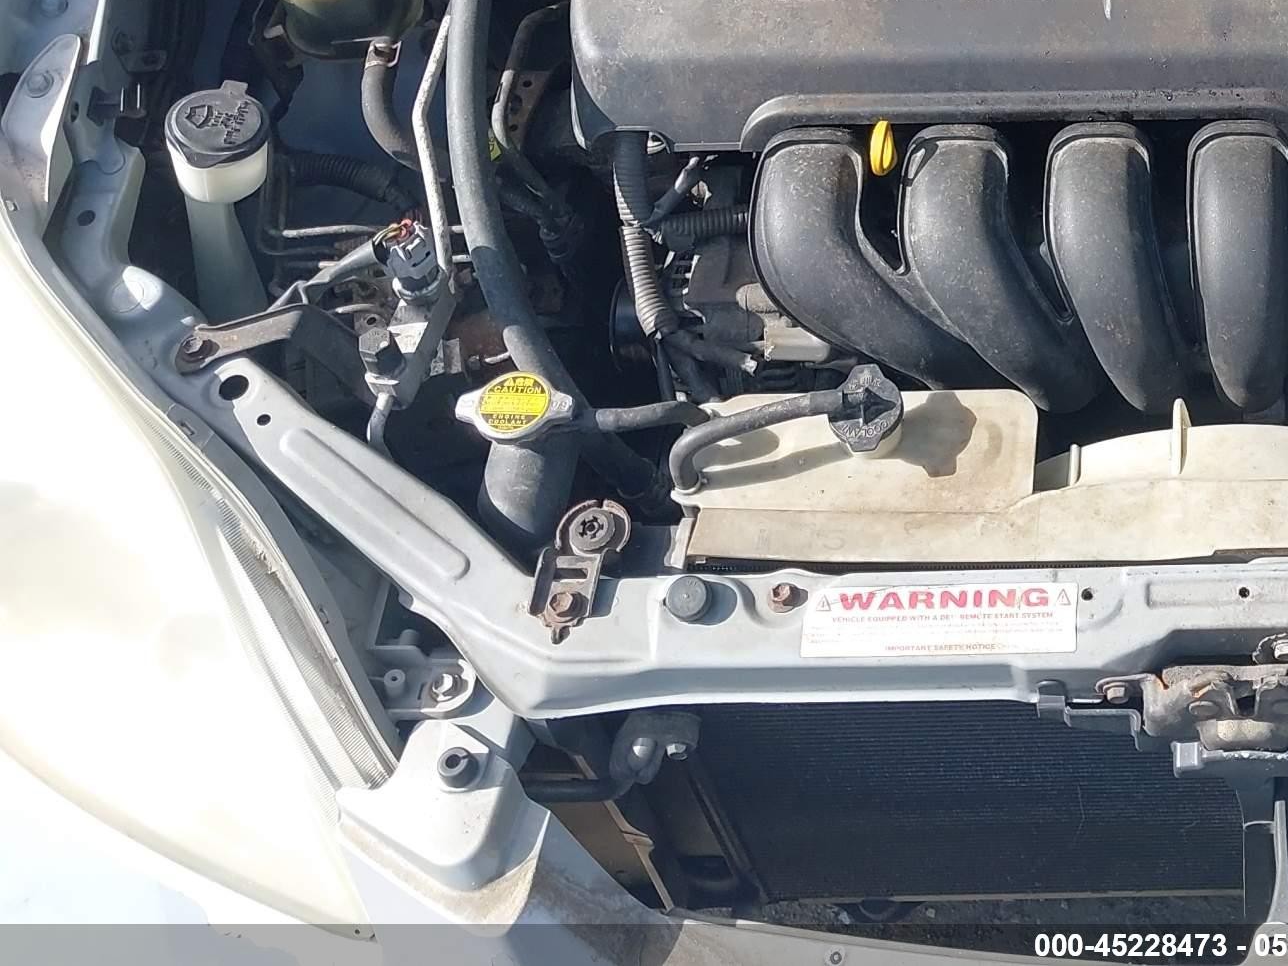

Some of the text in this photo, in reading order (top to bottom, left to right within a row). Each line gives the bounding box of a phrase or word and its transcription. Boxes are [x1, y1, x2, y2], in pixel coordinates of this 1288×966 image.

[494, 385, 542, 395] CAUTION
[839, 586, 1049, 611] WARNING
[832, 615, 866, 623] VEHICLE
[867, 614, 909, 622] EQUIPPED
[909, 614, 931, 622] WITH
[1021, 611, 1054, 619] SYSTEM
[885, 644, 932, 652] IMPORTANT
[934, 643, 965, 651] SAFETY
